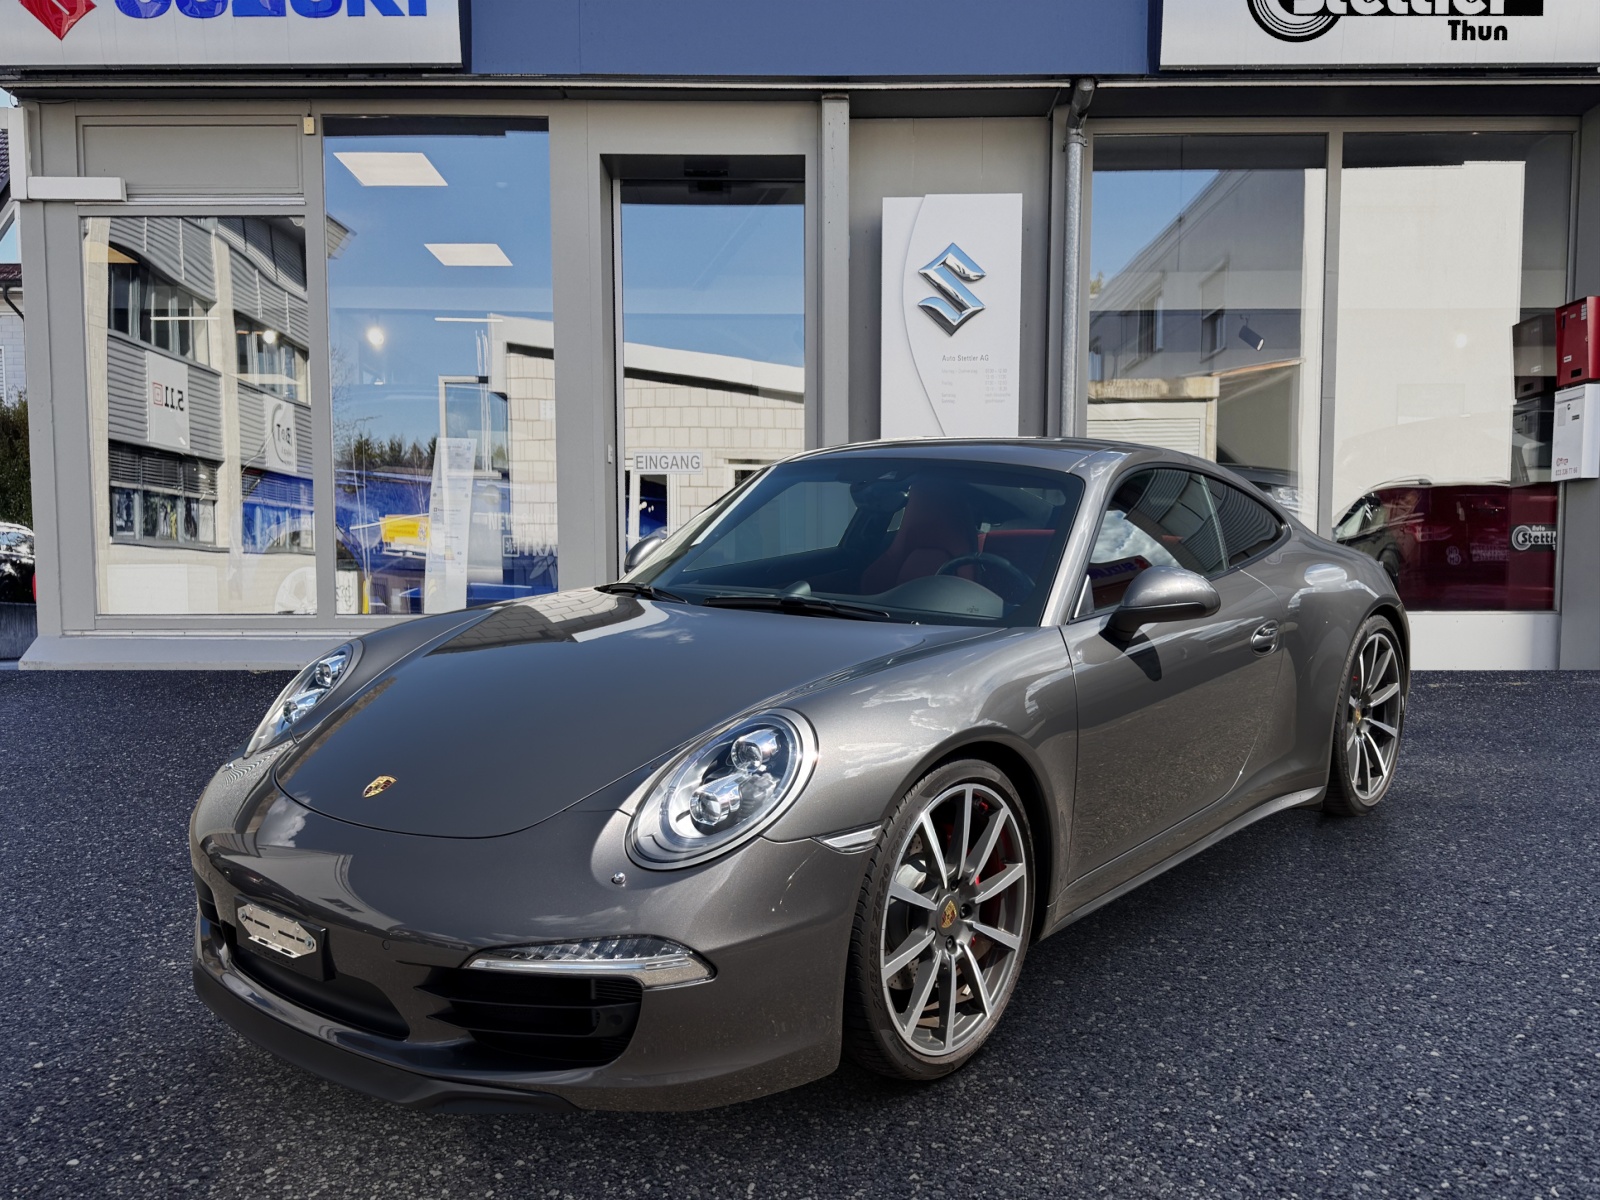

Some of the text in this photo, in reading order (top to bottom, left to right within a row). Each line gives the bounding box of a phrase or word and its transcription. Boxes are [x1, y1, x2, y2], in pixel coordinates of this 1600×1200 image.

[1448, 20, 1508, 41] Thun
[942, 354, 956, 362] Auto
[957, 354, 978, 362] Stettler
[635, 455, 701, 470] EINGANG
